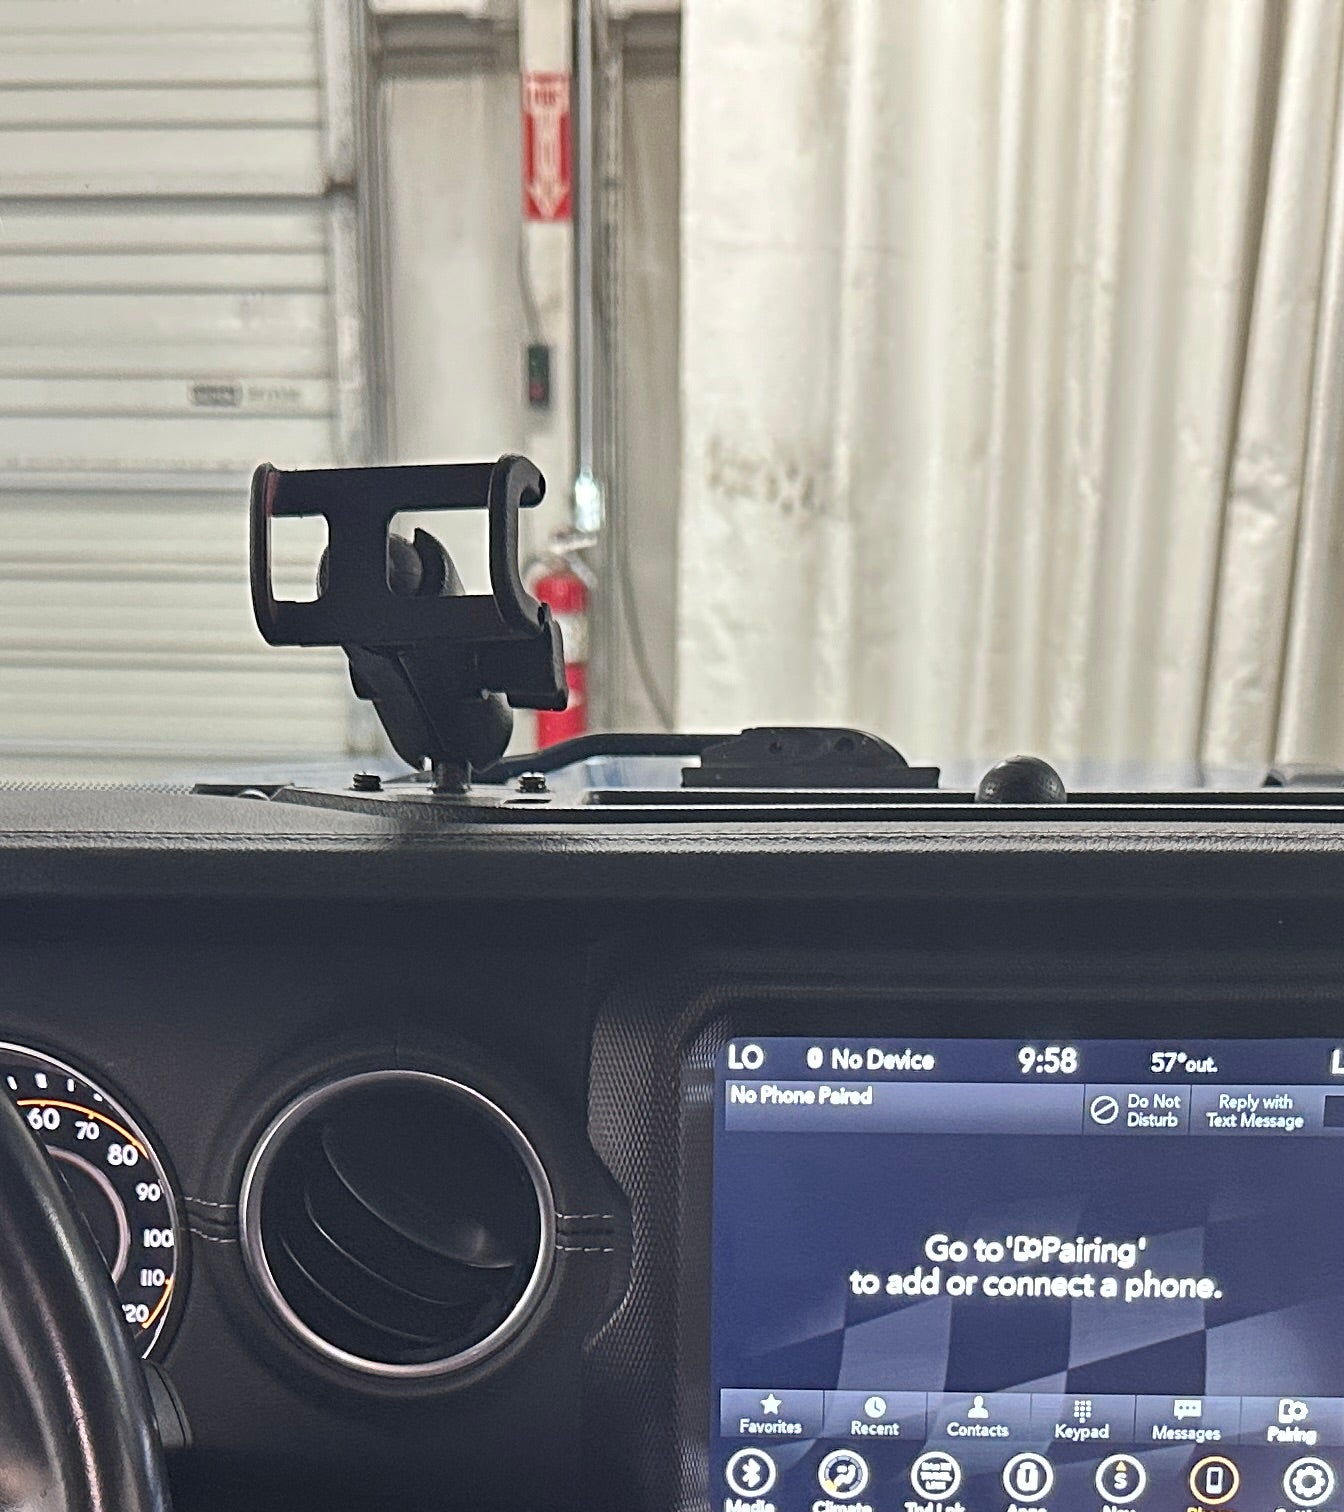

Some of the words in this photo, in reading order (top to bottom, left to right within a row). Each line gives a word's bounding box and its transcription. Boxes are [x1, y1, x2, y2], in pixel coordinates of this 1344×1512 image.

[728, 1044, 764, 1069] LO
[831, 1047, 863, 1070] No
[867, 1047, 935, 1071] Device
[1018, 1046, 1078, 1074] 9:58
[730, 1084, 757, 1104] No
[760, 1085, 816, 1105] Phone
[818, 1085, 873, 1105] Paired
[1127, 1093, 1149, 1109] Do
[1153, 1093, 1182, 1109] Not
[1219, 1093, 1257, 1112] Reply
[1261, 1093, 1293, 1110] with
[27, 1107, 60, 1130] 60
[1127, 1111, 1178, 1128] Disturb
[1206, 1111, 1236, 1127] Text
[1239, 1112, 1304, 1131] Message
[75, 1120, 100, 1140] 70
[107, 1143, 138, 1166] 80
[136, 1182, 161, 1201] 90
[143, 1229, 174, 1248] 100
[924, 1233, 968, 1261] Go
[973, 1236, 1003, 1263] to
[140, 1269, 165, 1287] 110
[850, 1269, 880, 1294] to
[885, 1266, 940, 1296] add
[945, 1275, 977, 1297] or
[982, 1273, 1094, 1299] connect
[1099, 1277, 1119, 1298] a
[1124, 1270, 1223, 1302] phone.
[739, 1418, 802, 1434] Favorites
[851, 1420, 900, 1437] Recent
[946, 1421, 1009, 1438] Contacts
[1054, 1423, 1110, 1441] Keypad
[1152, 1425, 1221, 1442] Messages
[1267, 1426, 1317, 1445] Pairing
